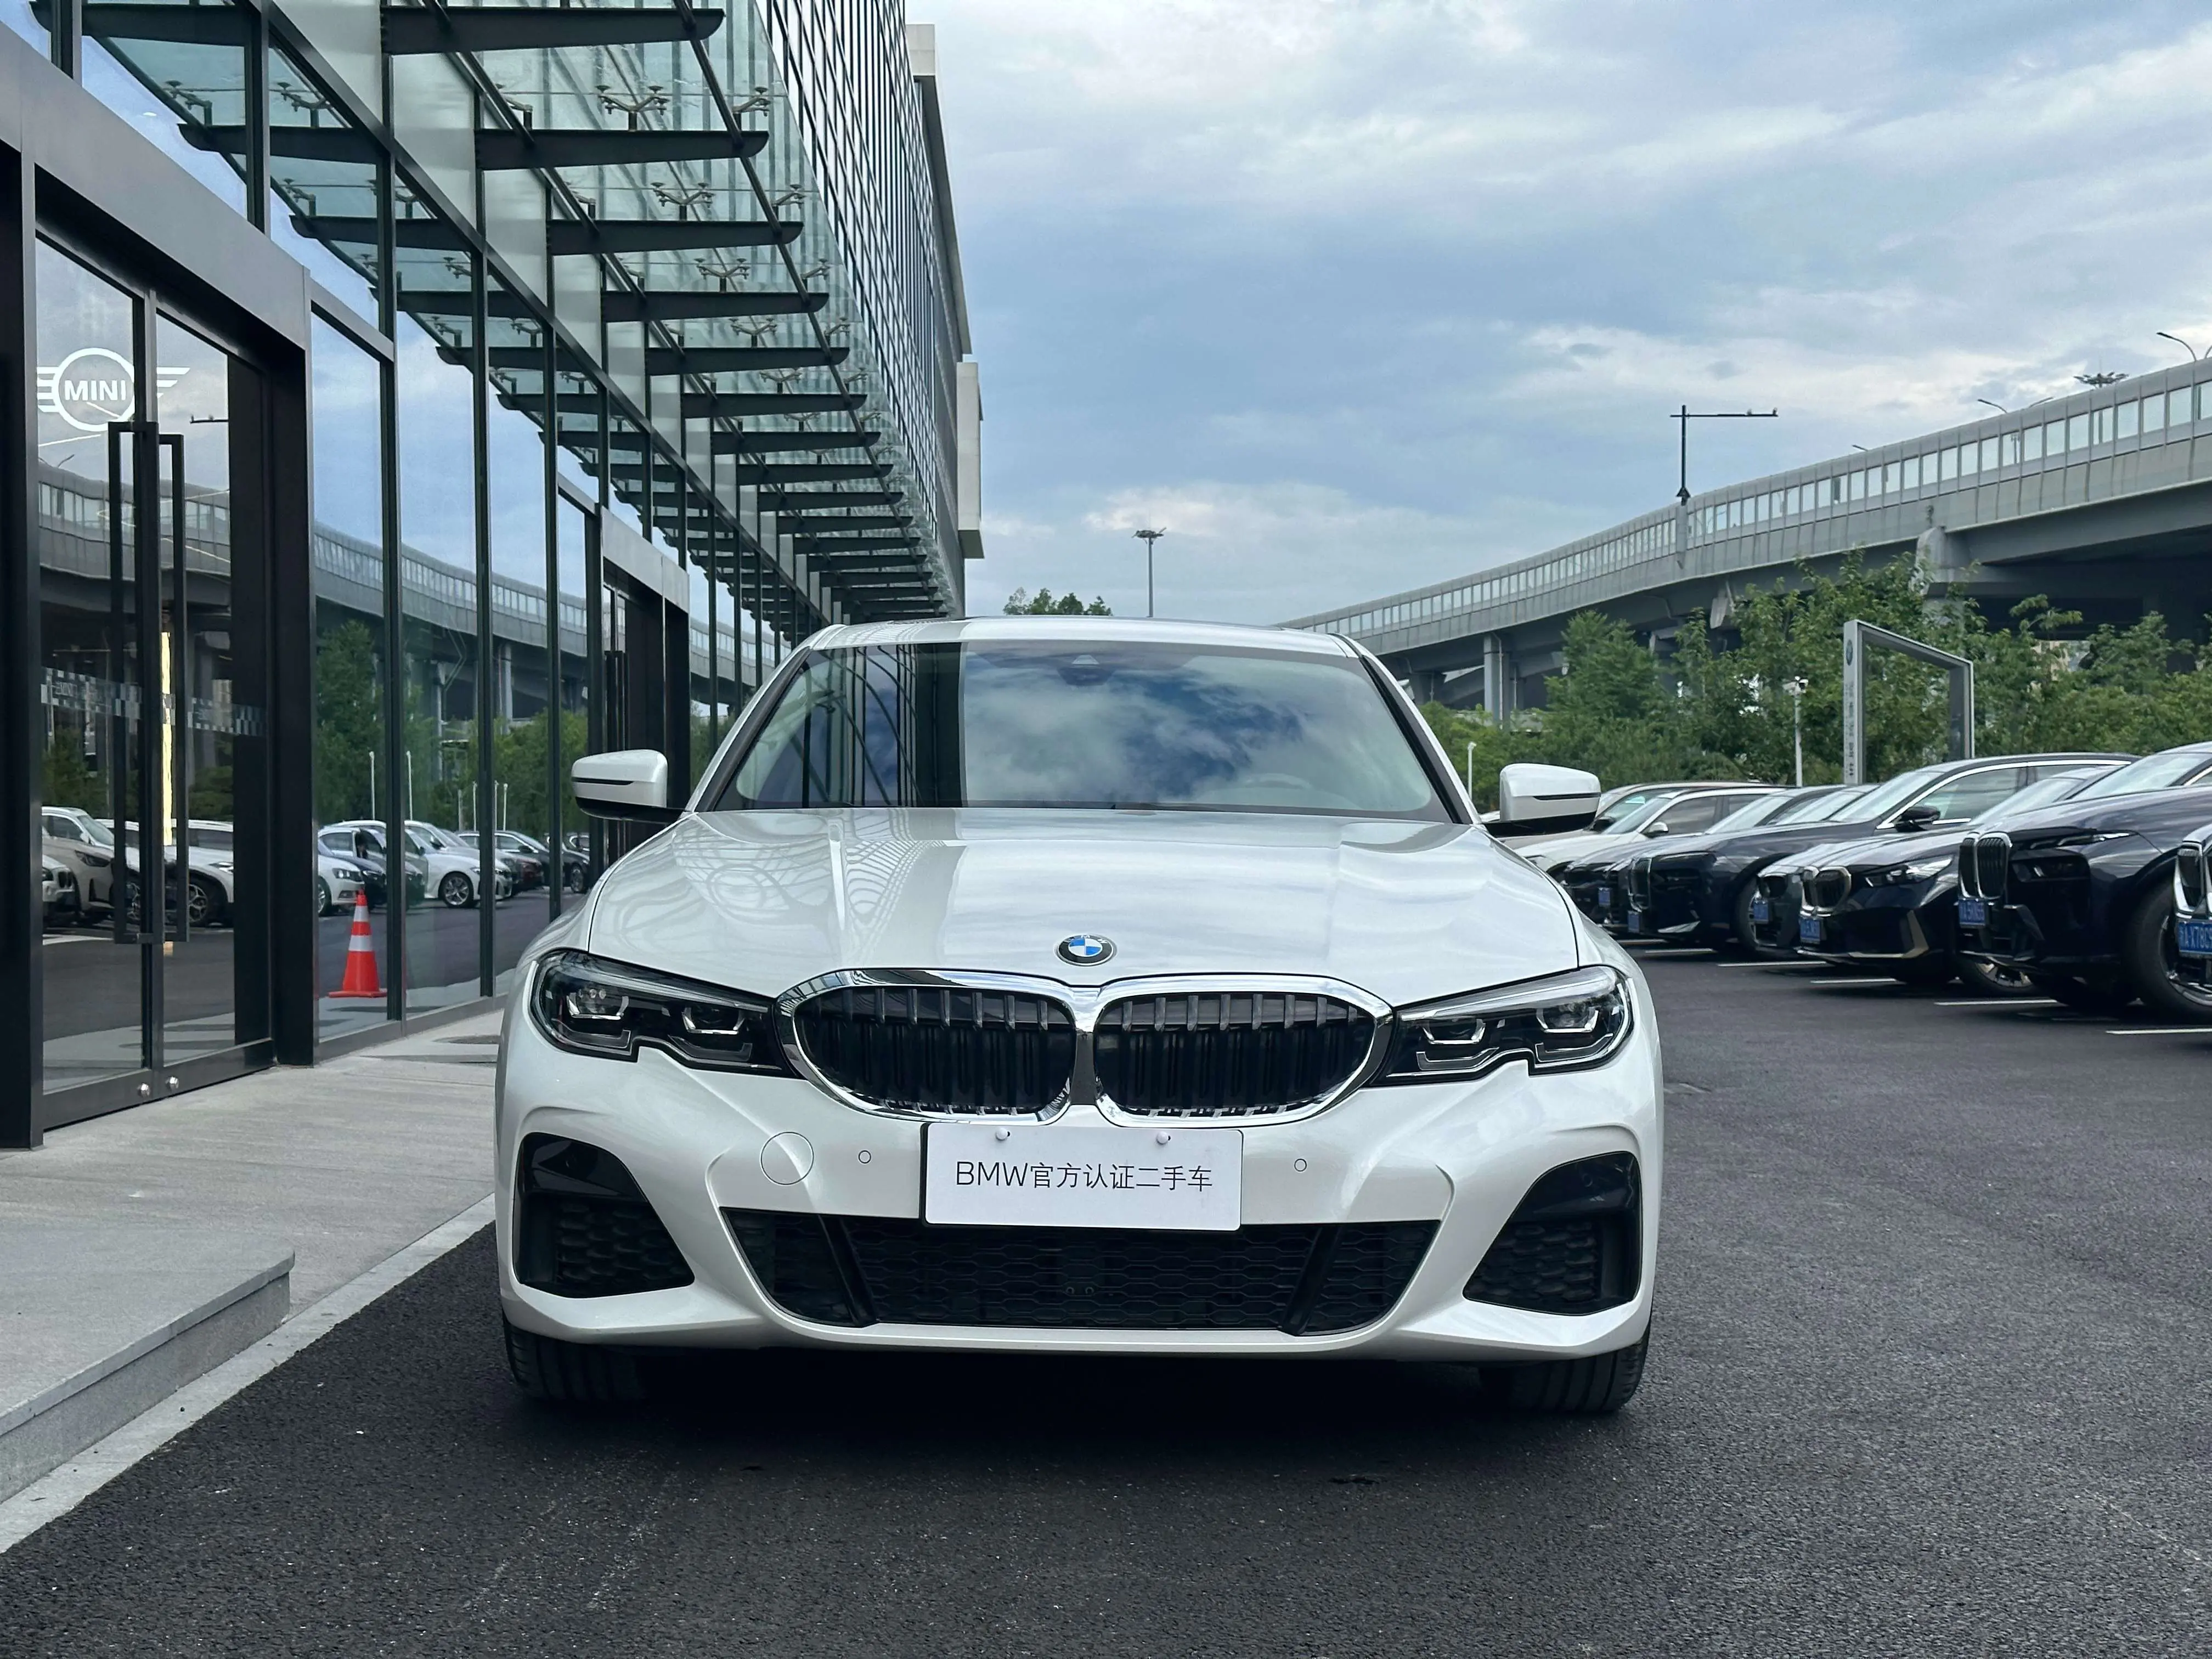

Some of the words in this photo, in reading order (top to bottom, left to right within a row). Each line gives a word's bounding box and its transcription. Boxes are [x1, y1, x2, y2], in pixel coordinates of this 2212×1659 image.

[65, 380, 126, 401] MINI
[956, 1161, 1212, 1192] BMW官方认证二手车
